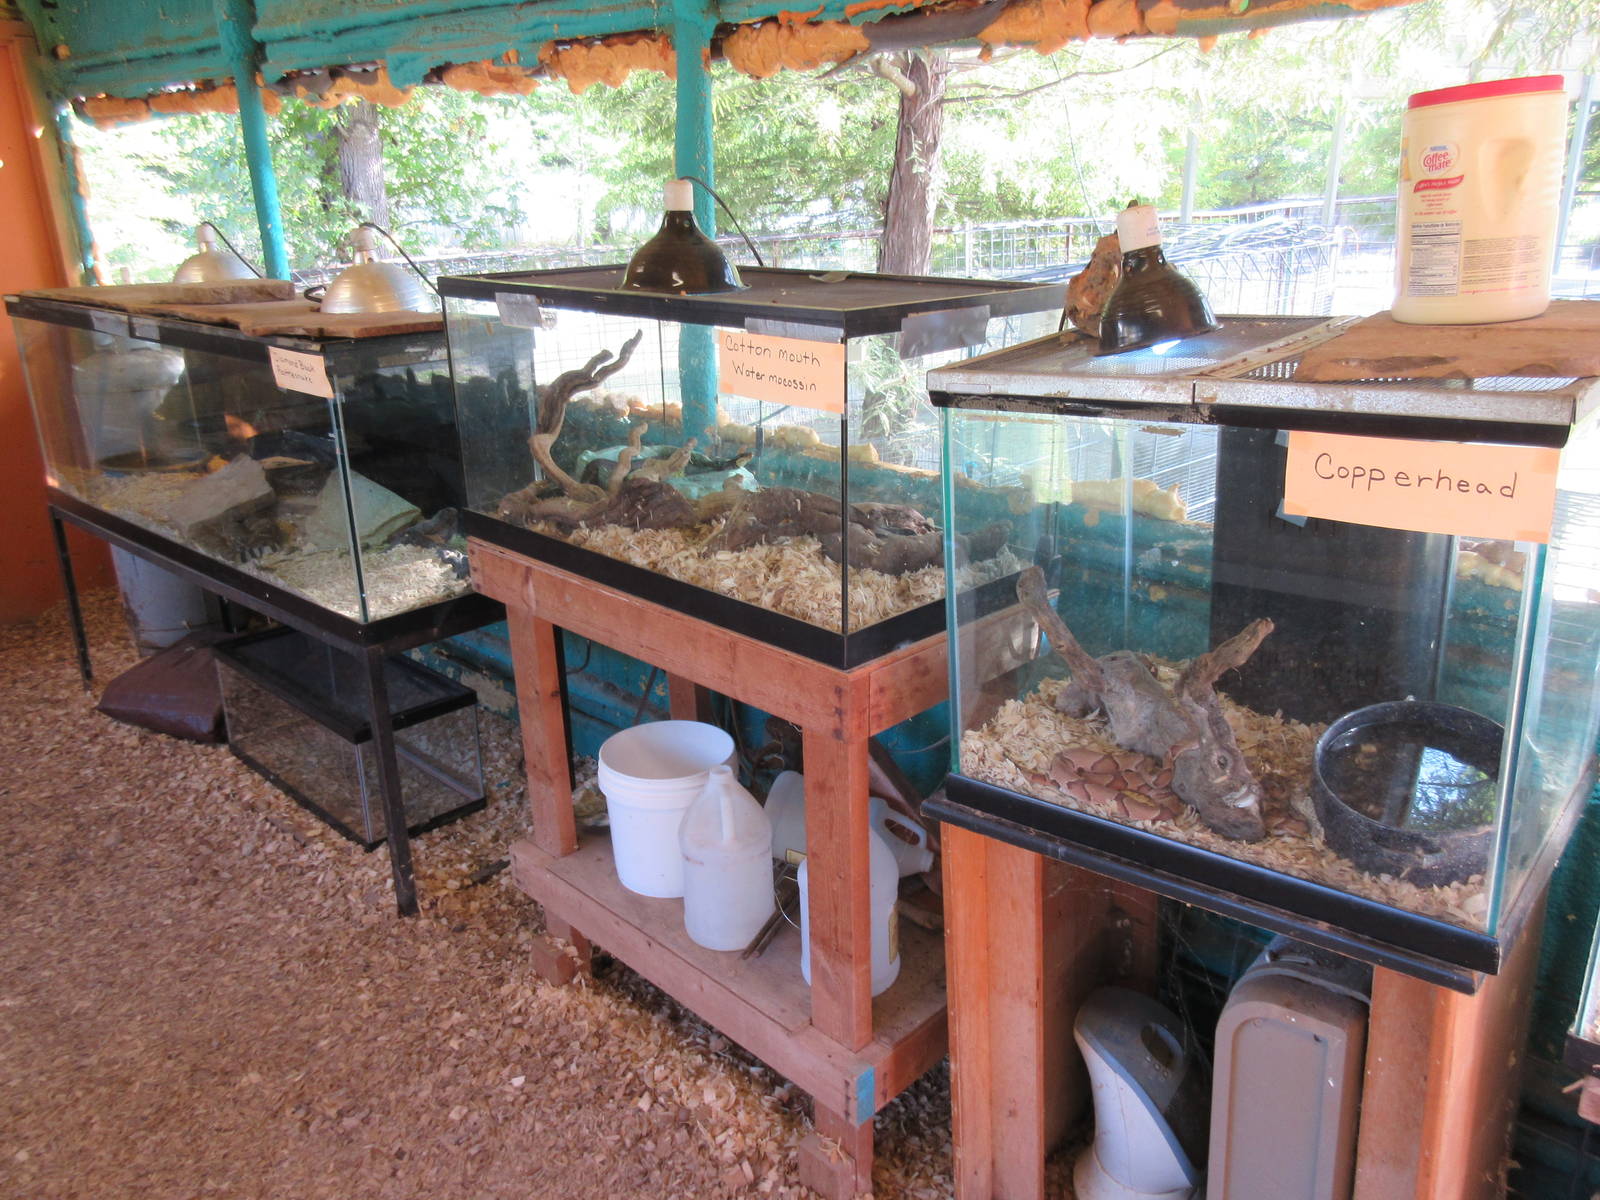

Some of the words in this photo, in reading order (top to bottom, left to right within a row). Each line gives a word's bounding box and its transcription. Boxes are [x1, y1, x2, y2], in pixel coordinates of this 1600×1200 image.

[1423, 152, 1449, 168] Coffee
[1428, 160, 1452, 173] mate
[725, 335, 772, 359] Cotton
[732, 359, 766, 381] Water
[1314, 452, 1518, 499] Copperhead
